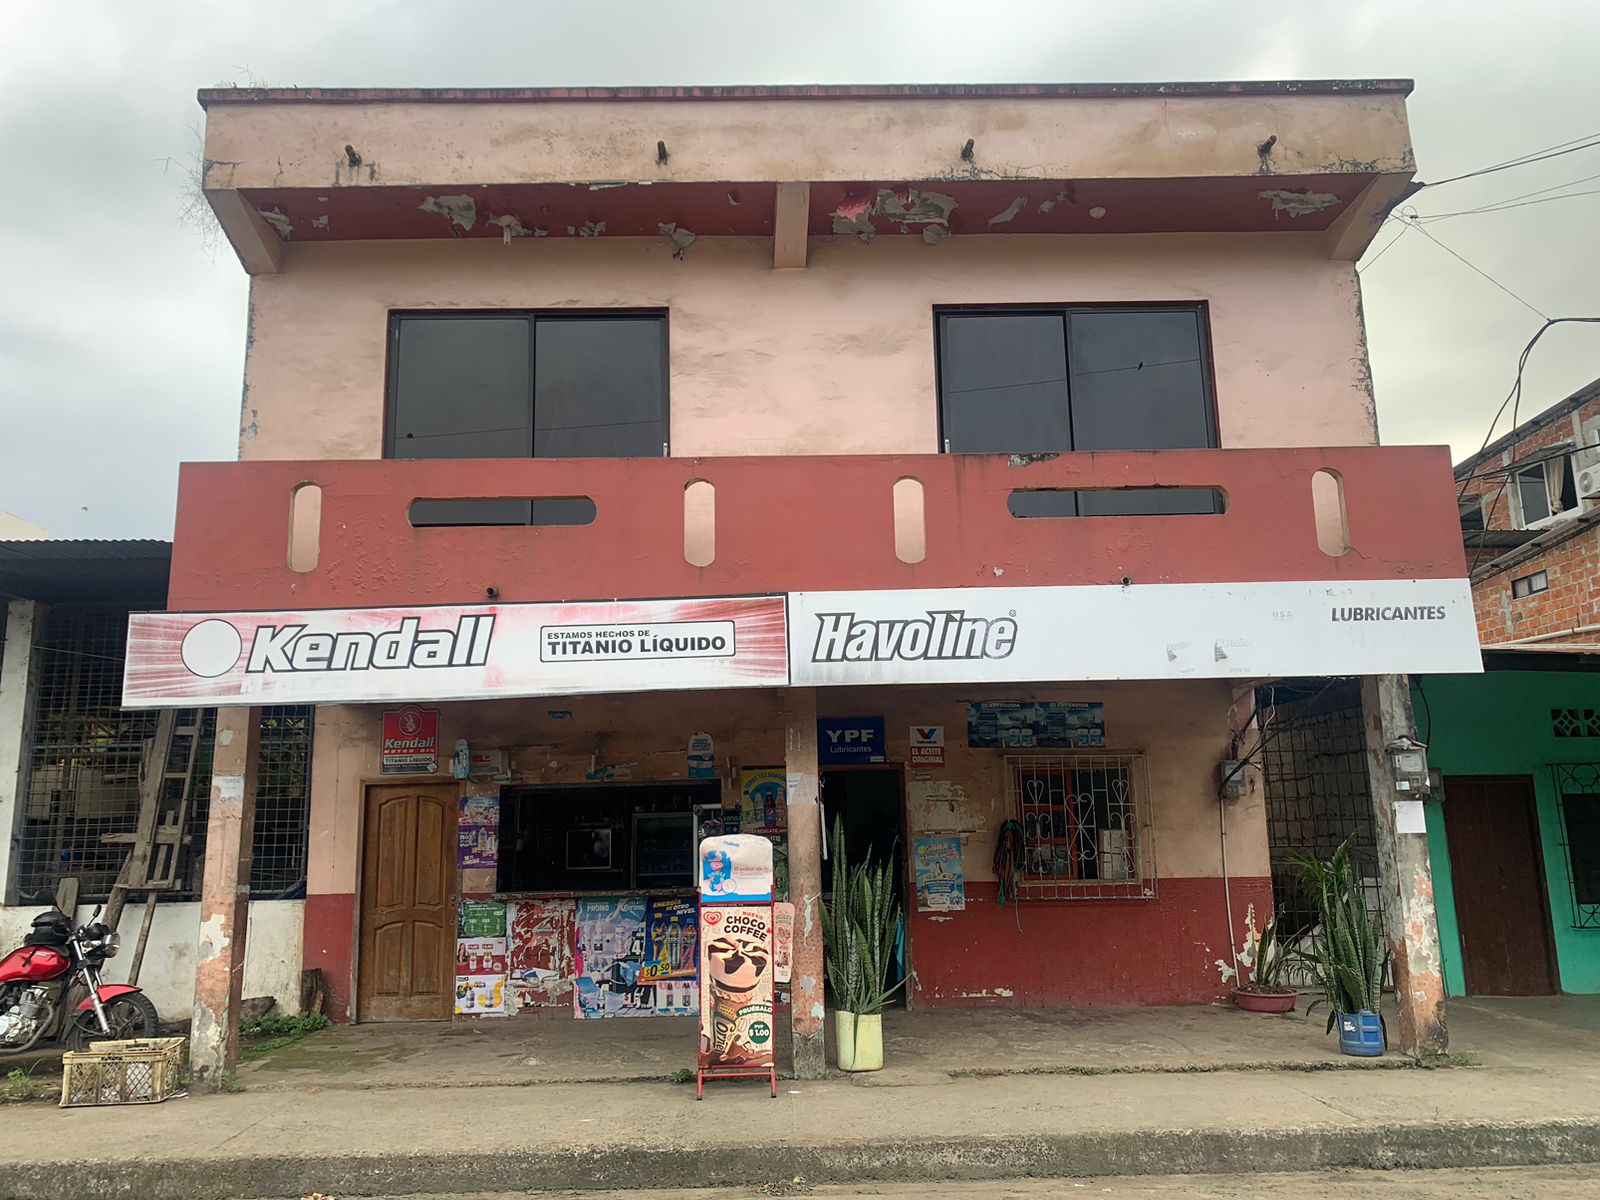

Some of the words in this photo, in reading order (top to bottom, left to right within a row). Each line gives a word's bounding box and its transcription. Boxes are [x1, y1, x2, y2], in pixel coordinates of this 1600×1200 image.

[1331, 606, 1446, 621] LUBRICANTES
[547, 631, 593, 640] ESTAMOS
[595, 630, 635, 639] HECHOS
[811, 609, 1018, 663] Havoline
[245, 614, 497, 674] Kendall
[547, 639, 633, 656] TITANIO
[640, 635, 726, 653] LÍQUIDO
[385, 736, 435, 749] Kendall
[826, 729, 874, 743] YPF
[830, 745, 872, 753] Lubricantes
[911, 756, 944, 764] ORIGINAL
[653, 899, 681, 908] ENERGÍA
[742, 911, 764, 920] NUEVO
[726, 916, 766, 931] CHOCO
[724, 925, 768, 942] COFFEE
[738, 1005, 772, 1016] PRUÉBALO
